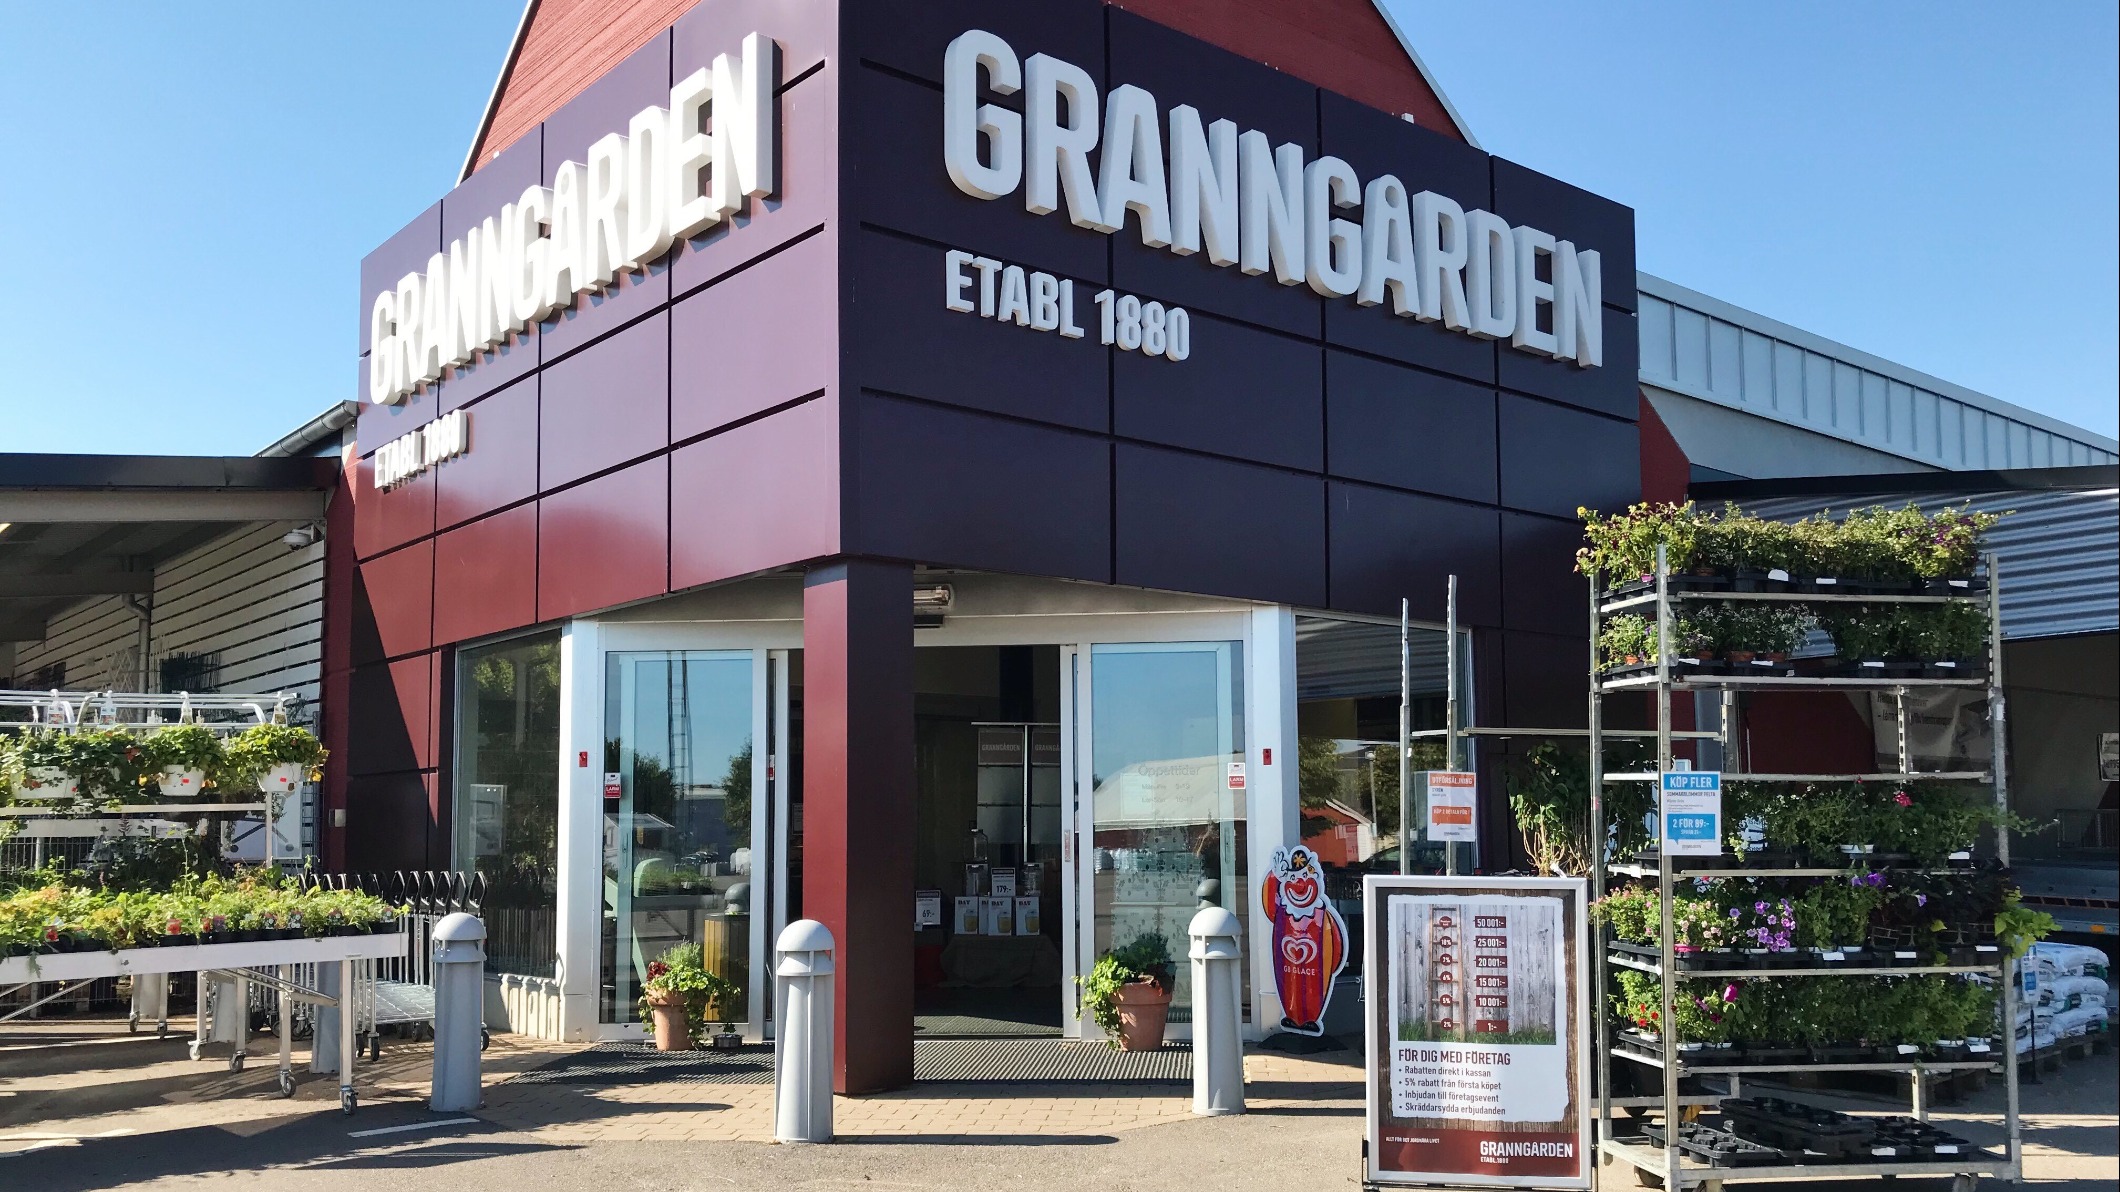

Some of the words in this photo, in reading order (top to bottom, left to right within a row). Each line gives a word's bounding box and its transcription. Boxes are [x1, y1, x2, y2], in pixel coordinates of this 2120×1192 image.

[944, 29, 1602, 369] GRANNGÅRDEN
[370, 31, 782, 405] GRANNGÅRDEN
[945, 249, 1084, 339] ETABL
[1094, 289, 1190, 363] 1880
[375, 430, 424, 489] ETABL
[423, 408, 468, 466] 1880
[981, 743, 1021, 752] GRANNGÅRDEN
[1138, 764, 1200, 778] Öppettider
[1669, 775, 1688, 788] KÖP
[1690, 776, 1713, 788] FLER
[1672, 818, 1678, 828] 2
[1679, 817, 1694, 828] FÖR
[996, 885, 1012, 893] 179:-
[1477, 918, 1486, 927] 50
[1478, 938, 1487, 947] 25
[1478, 958, 1487, 967] 20
[1292, 966, 1316, 976] GLACE
[1479, 978, 1487, 987] 15
[1479, 997, 1487, 1007] 10
[1487, 1022, 1498, 1032] 1:-
[1398, 1047, 1419, 1062] FÖR
[1420, 1049, 1438, 1063] DIG
[1440, 1050, 1463, 1064] MED
[1465, 1050, 1511, 1066] FÖRETAG
[1404, 1065, 1437, 1075] Rabatten
[1438, 1067, 1460, 1076] direkt
[1465, 1068, 1492, 1077] kassan
[1404, 1077, 1416, 1087] 5%
[1417, 1078, 1440, 1088] rabatt
[1441, 1079, 1456, 1088] från
[1457, 1080, 1480, 1089] första
[1480, 1081, 1502, 1091] köpet
[1405, 1090, 1436, 1101] Inbjudan
[1437, 1091, 1447, 1100] till
[1448, 1092, 1499, 1104] företagsevent
[1405, 1102, 1459, 1114] Skräddarsydda
[1460, 1105, 1506, 1116] erbjudanden
[1479, 1140, 1573, 1158] GRANNGÅRDEN
